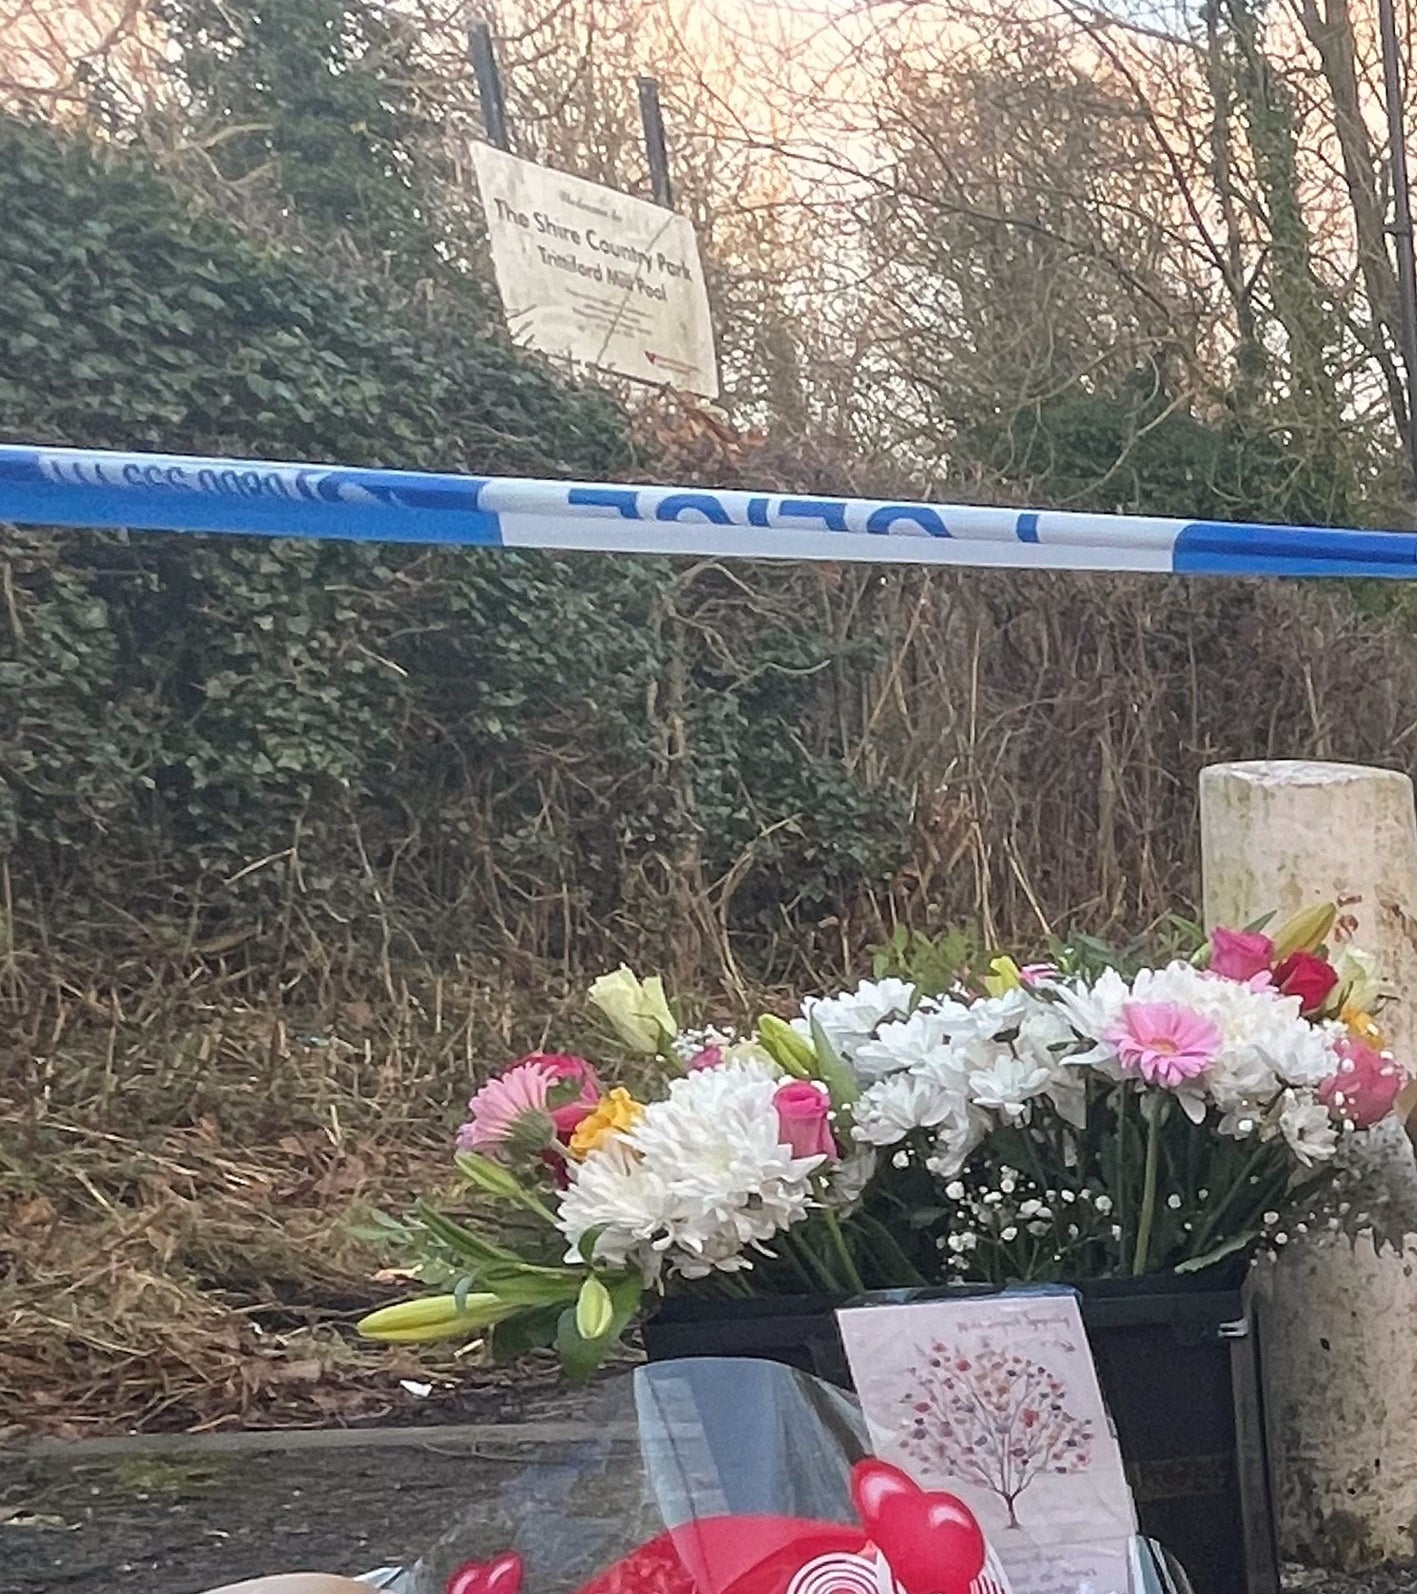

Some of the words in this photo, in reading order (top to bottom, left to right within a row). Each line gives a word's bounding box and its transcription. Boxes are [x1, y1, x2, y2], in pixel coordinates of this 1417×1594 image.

[493, 197, 529, 229] The
[533, 211, 582, 246] Shire
[585, 228, 653, 273] Country
[654, 251, 695, 282] Park
